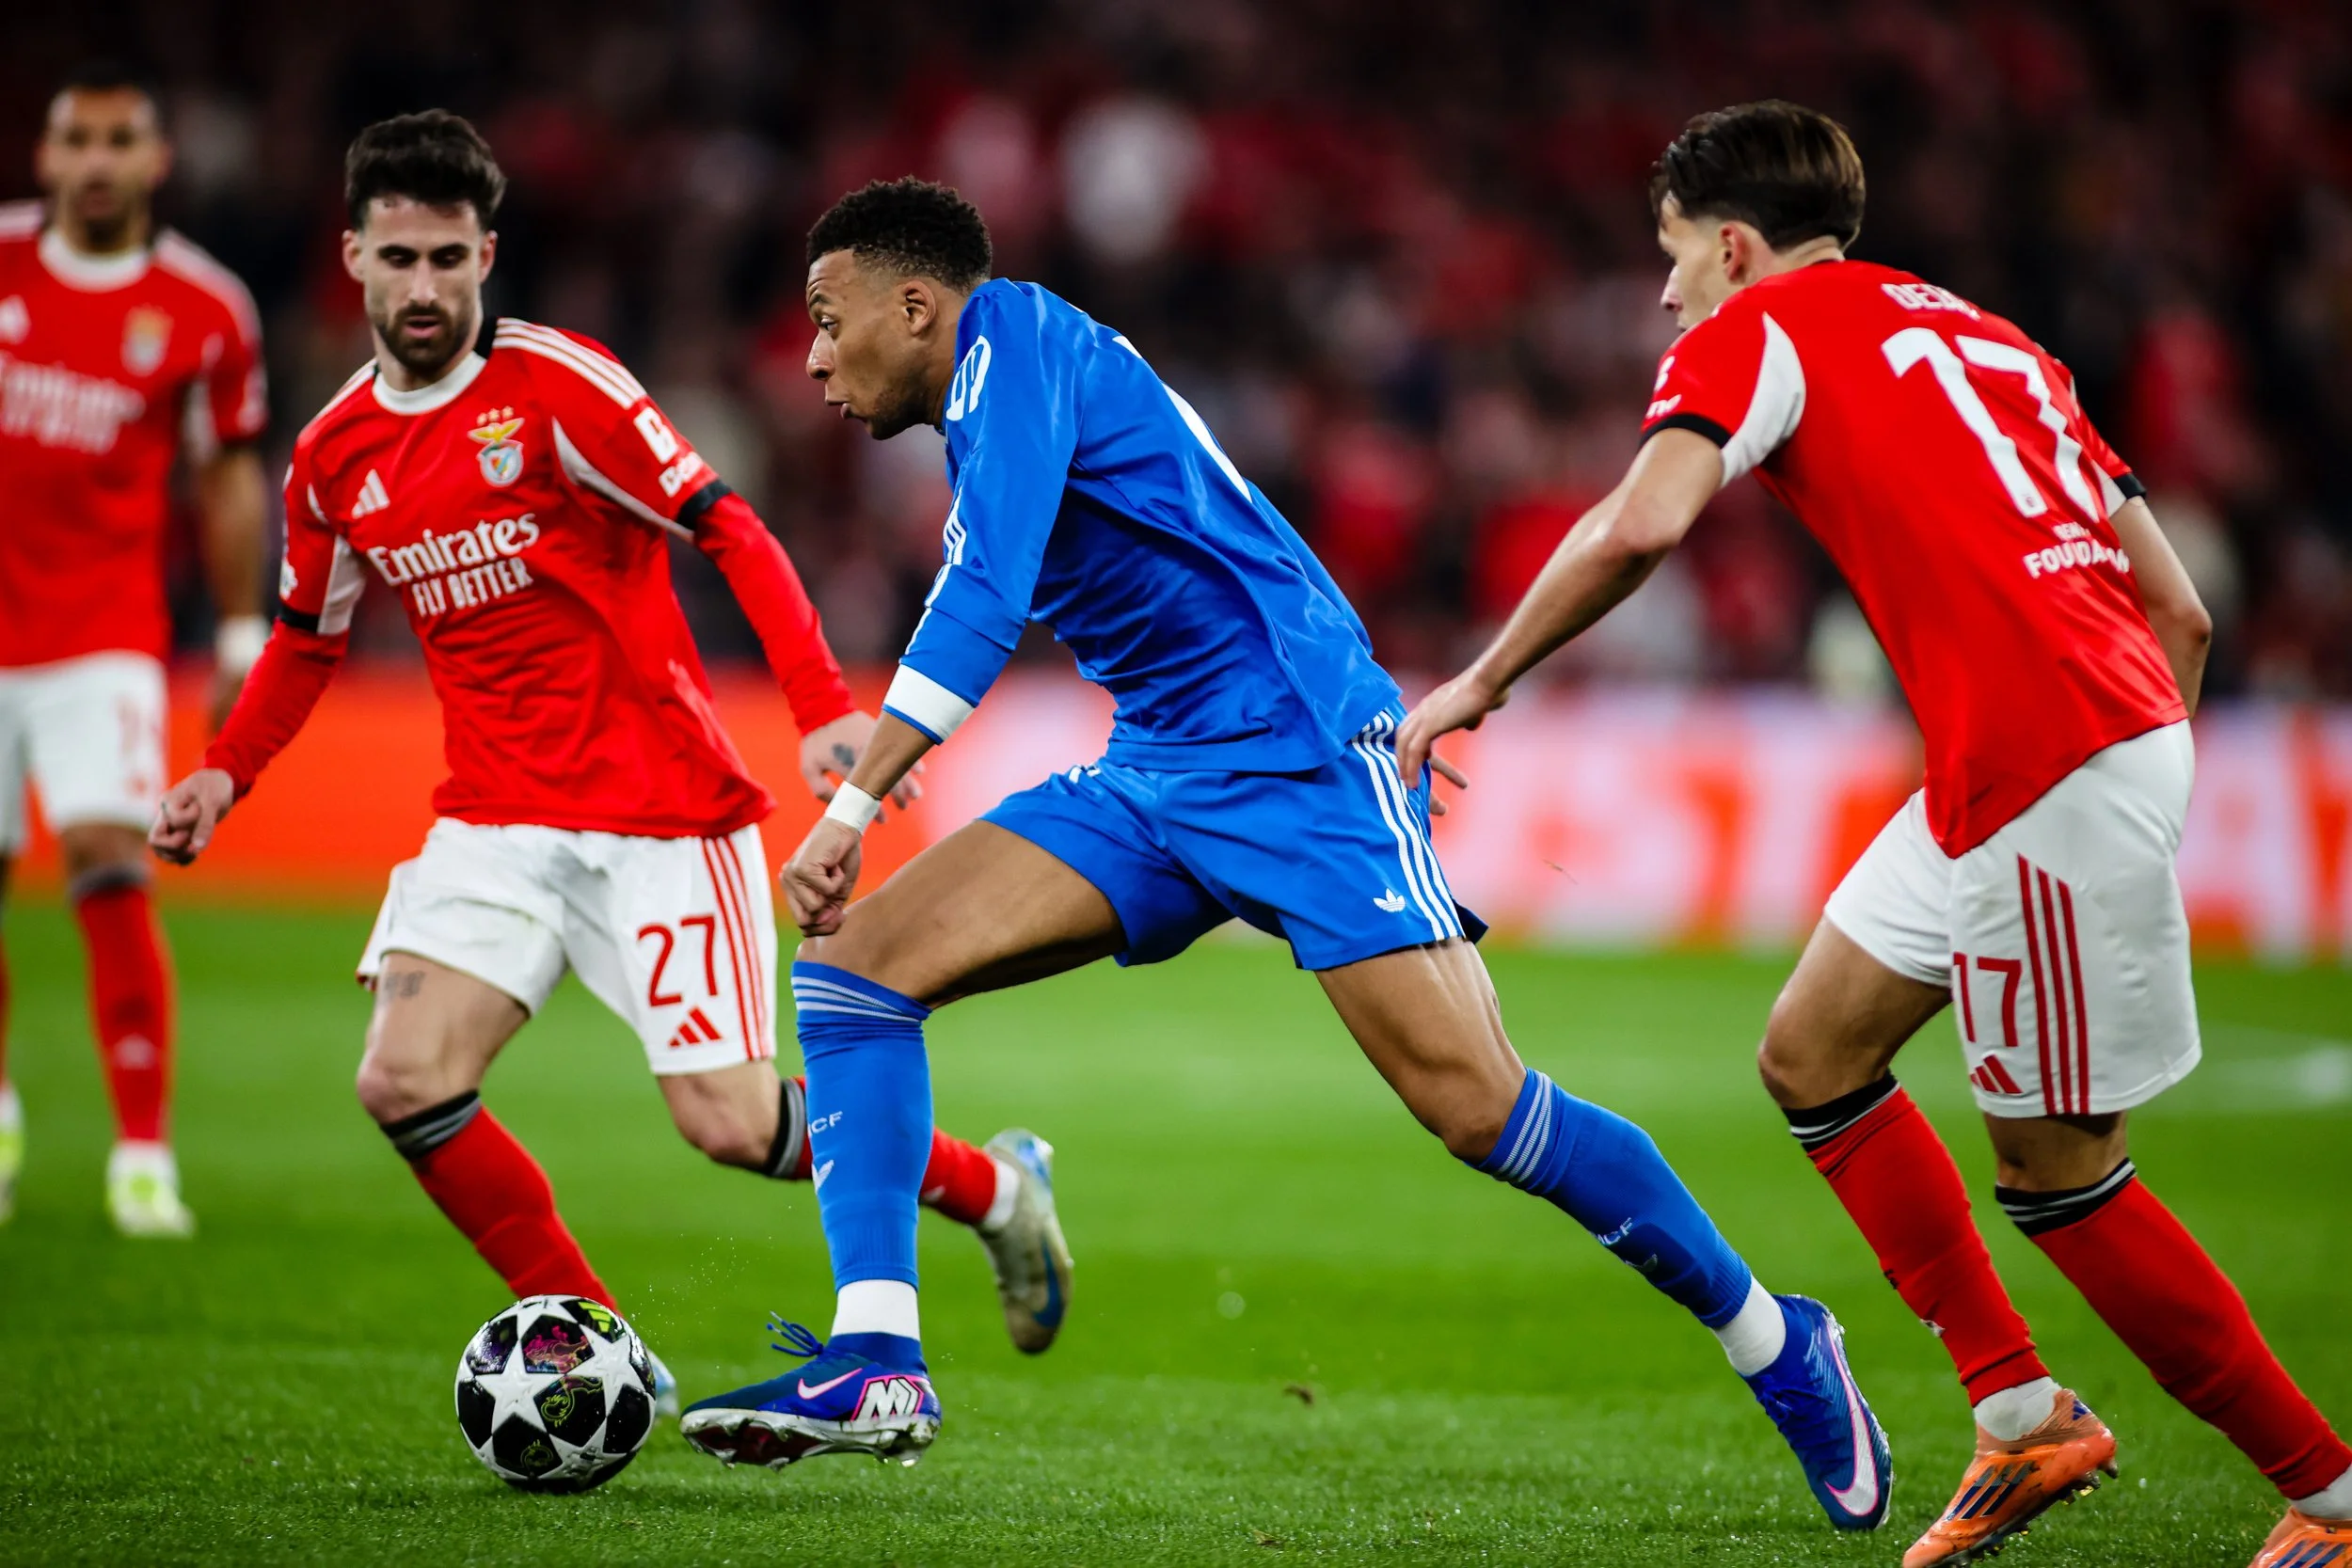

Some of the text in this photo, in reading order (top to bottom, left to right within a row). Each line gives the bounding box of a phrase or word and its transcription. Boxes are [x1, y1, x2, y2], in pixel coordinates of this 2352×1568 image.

[1883, 327, 2099, 522] 17
[367, 513, 540, 587] Emirates
[411, 556, 533, 617] FLY BETTER
[636, 914, 719, 1007] 27
[1952, 951, 2022, 1048] 17
[808, 1111, 843, 1137] CF
